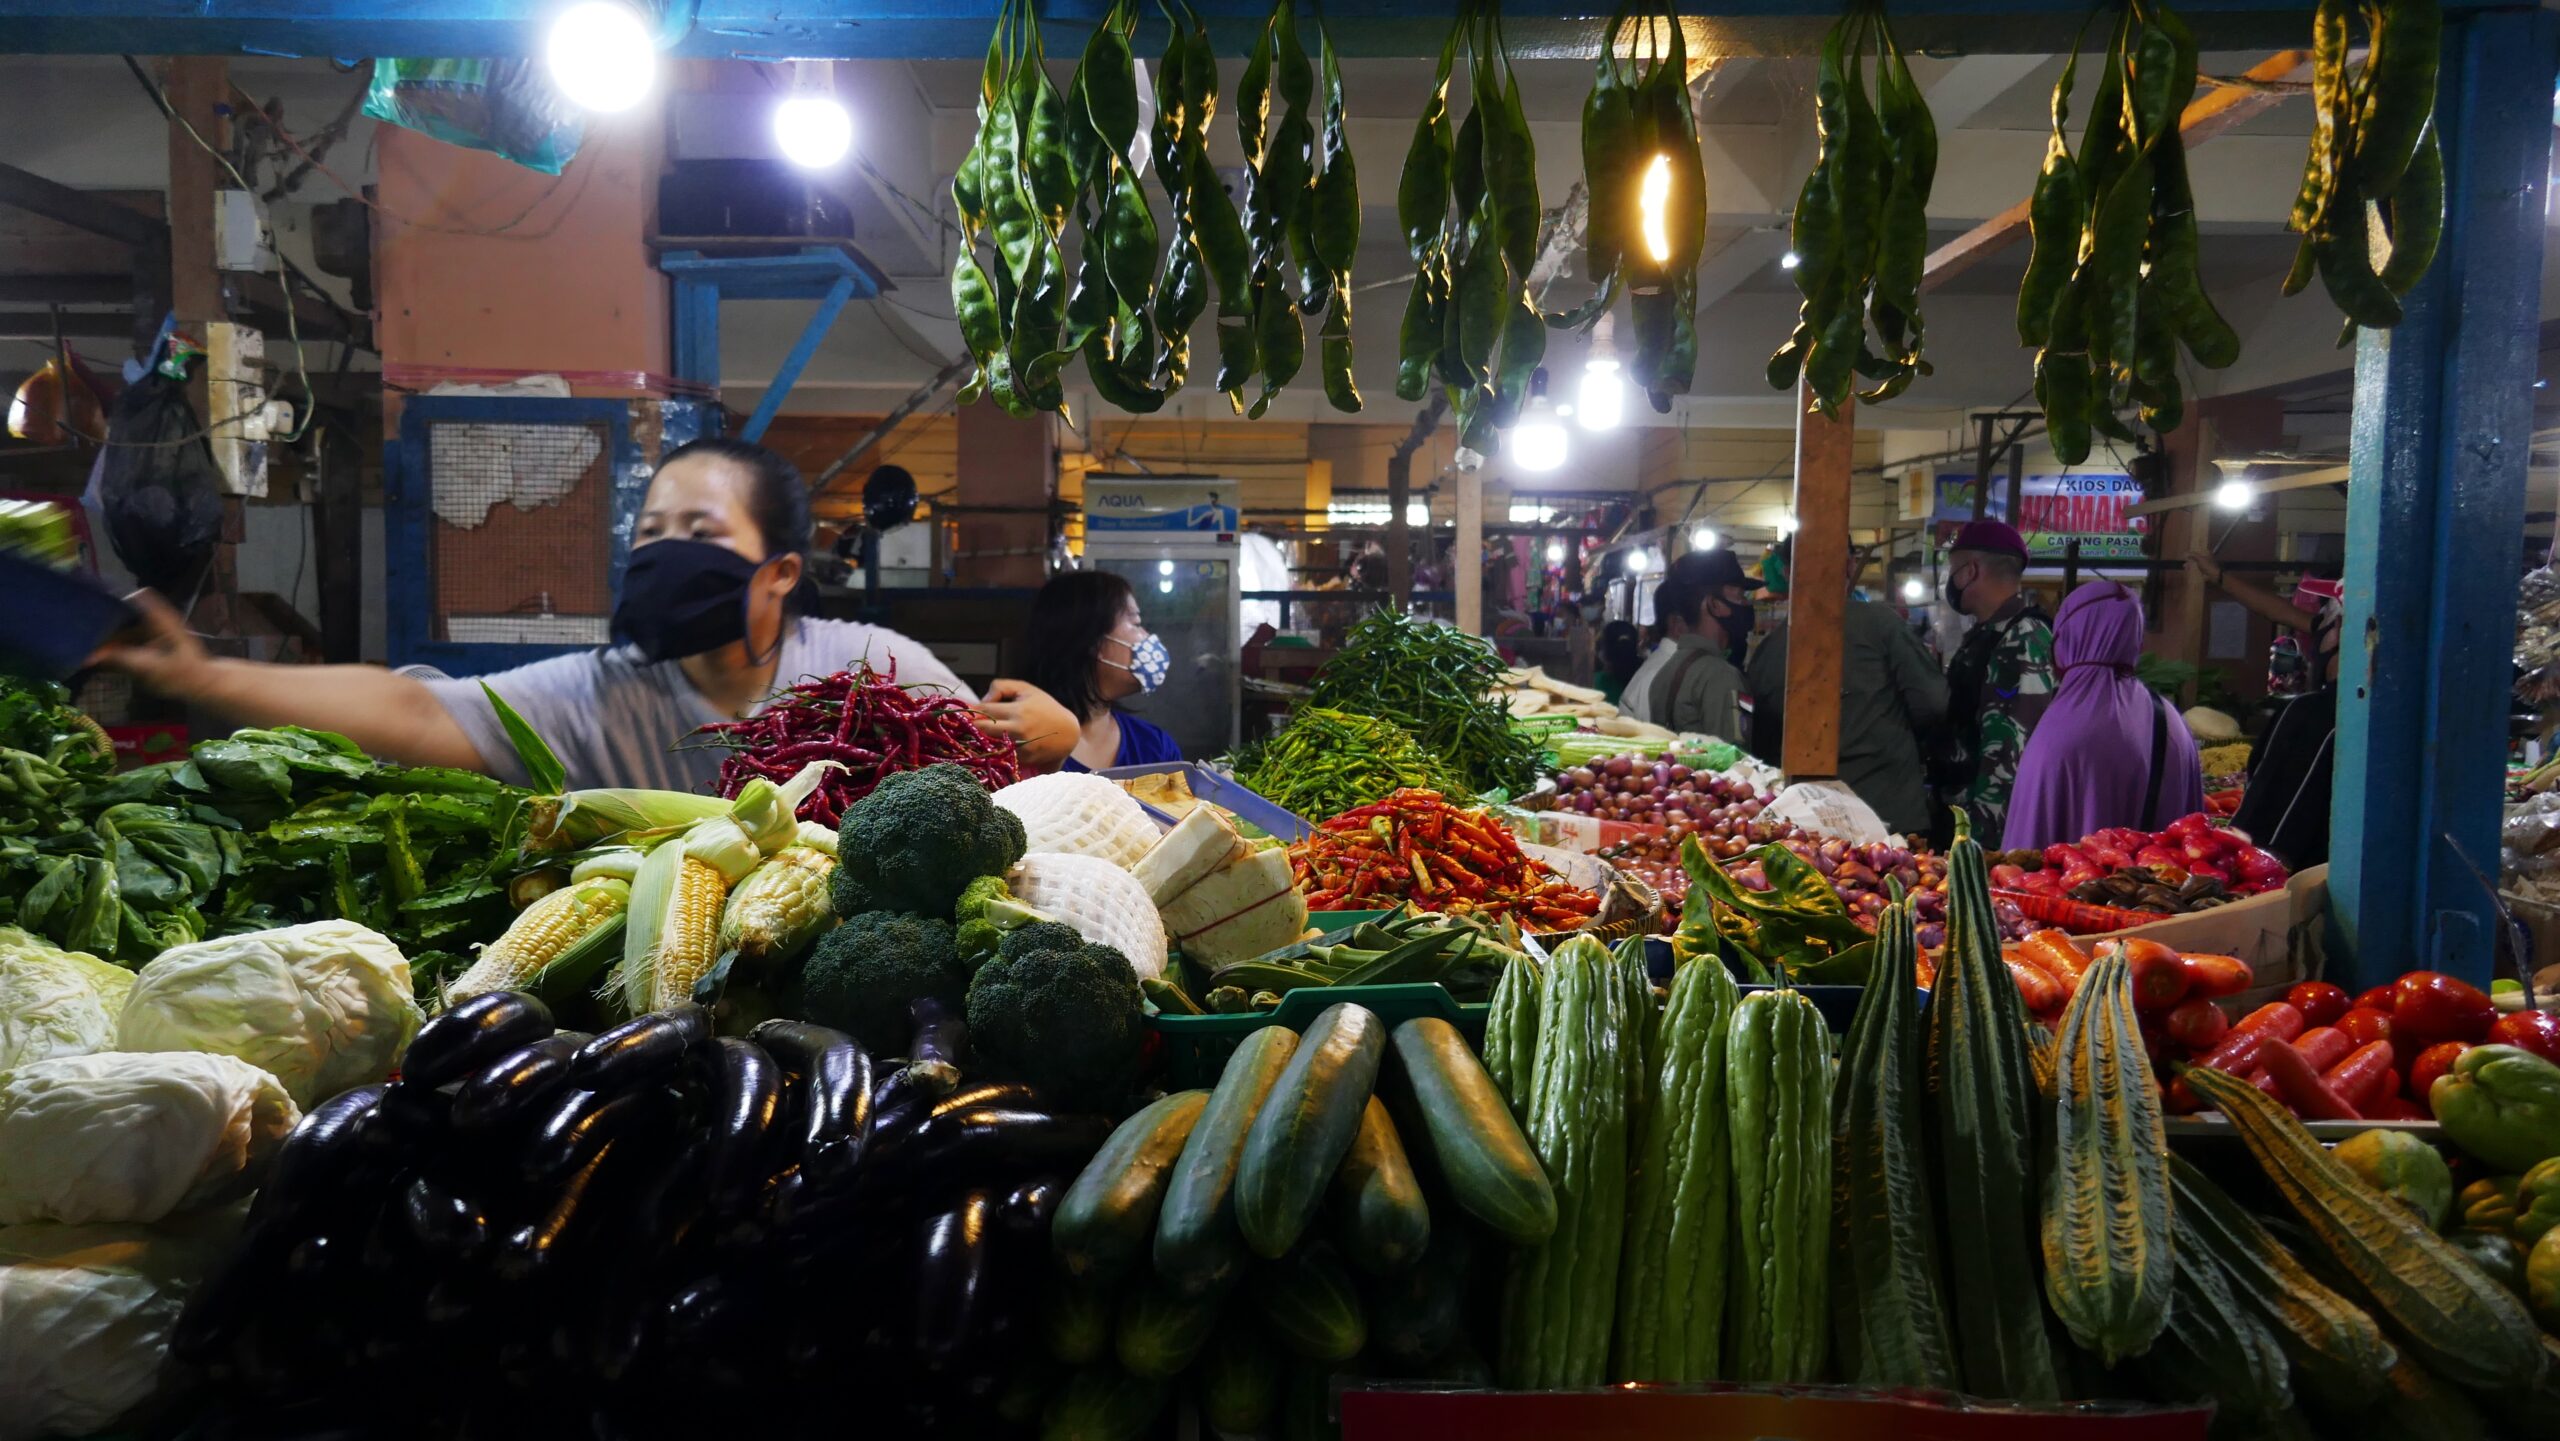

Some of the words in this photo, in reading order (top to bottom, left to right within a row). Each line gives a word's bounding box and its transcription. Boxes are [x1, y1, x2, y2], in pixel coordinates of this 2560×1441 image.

[2066, 480, 2106, 492] KIOS
[1098, 495, 1146, 507] AQUA
[2018, 495, 2131, 533] WIRMAN
[2106, 536, 2140, 546] PASA
